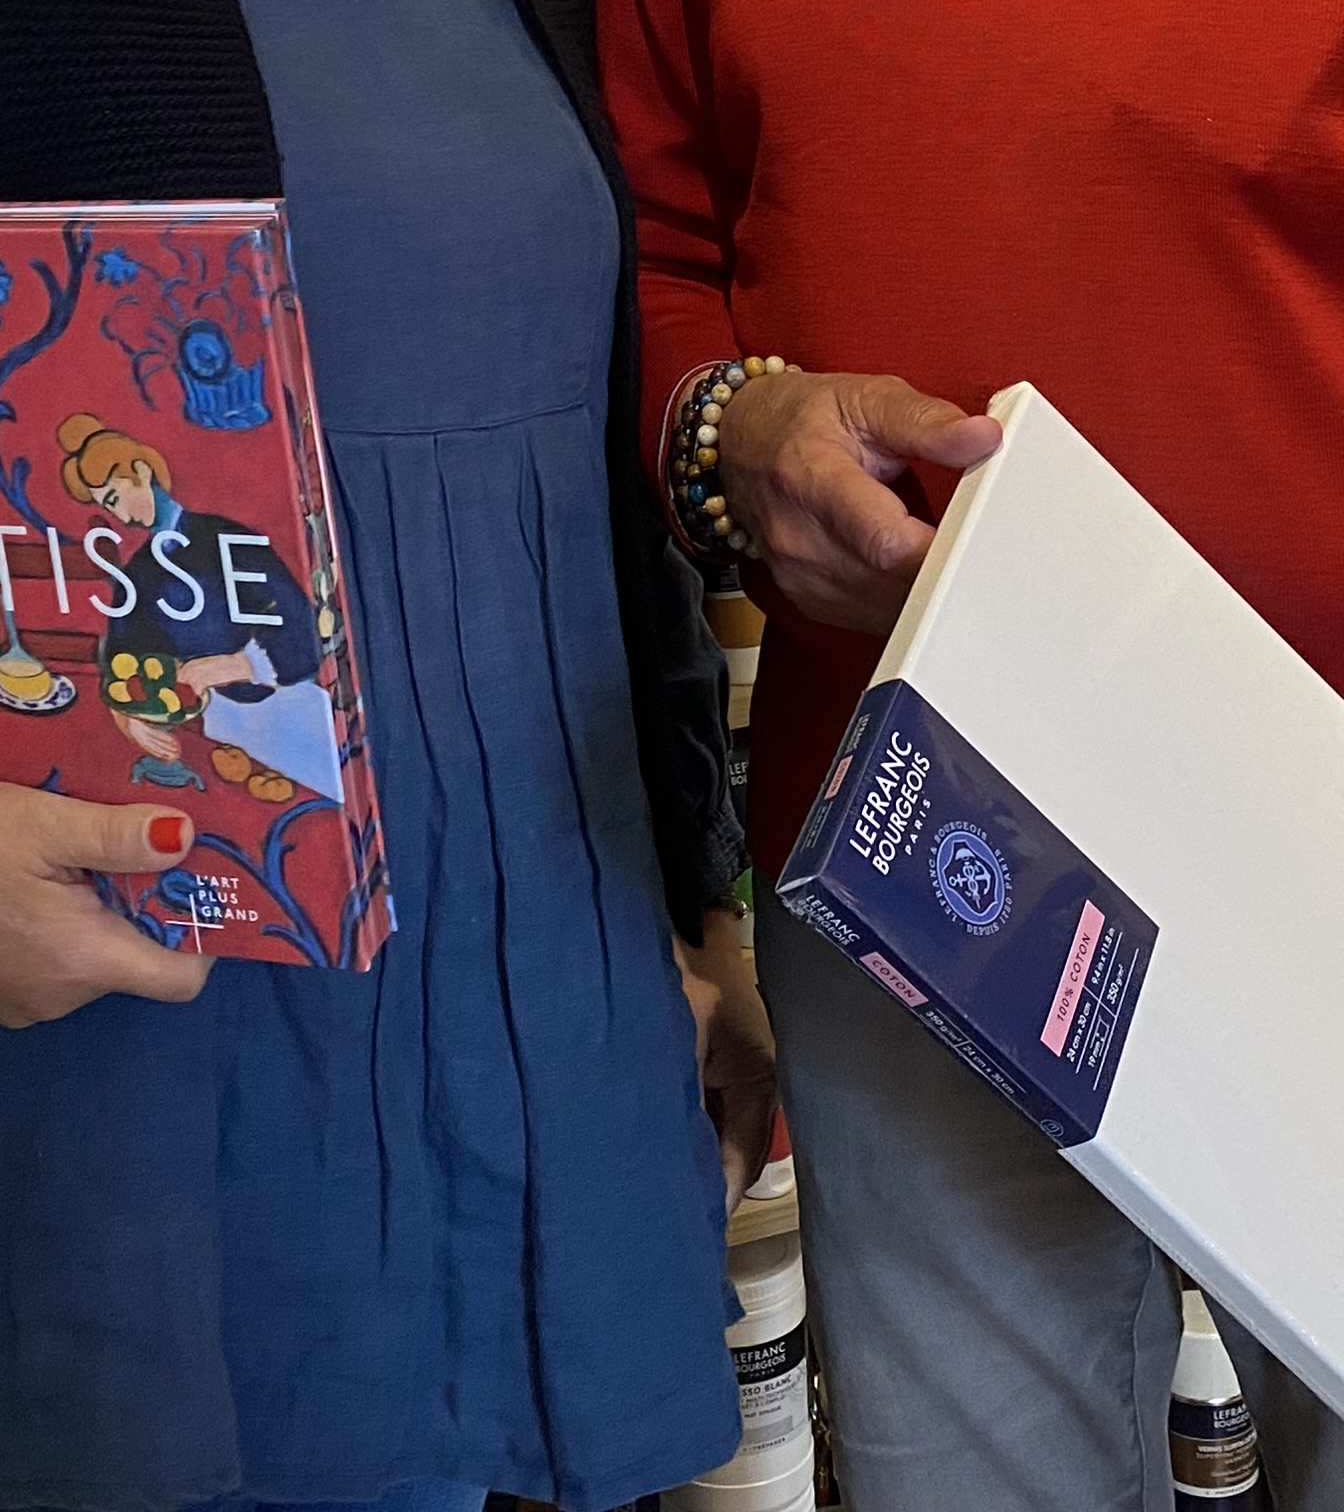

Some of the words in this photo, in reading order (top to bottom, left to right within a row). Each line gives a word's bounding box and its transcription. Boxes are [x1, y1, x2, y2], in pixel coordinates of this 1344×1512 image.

[848, 730, 913, 860] LEFRANC
[871, 750, 931, 876] BOURGEOIS
[904, 798, 932, 856] PARIS
[195, 873, 240, 890] L'ART
[198, 889, 239, 905] PLUS
[201, 904, 259, 923] GRAND
[805, 893, 861, 943] LEFRANC
[871, 959, 916, 1000] COTON
[1056, 986, 1075, 1023] 100%
[1069, 931, 1092, 983] COTON
